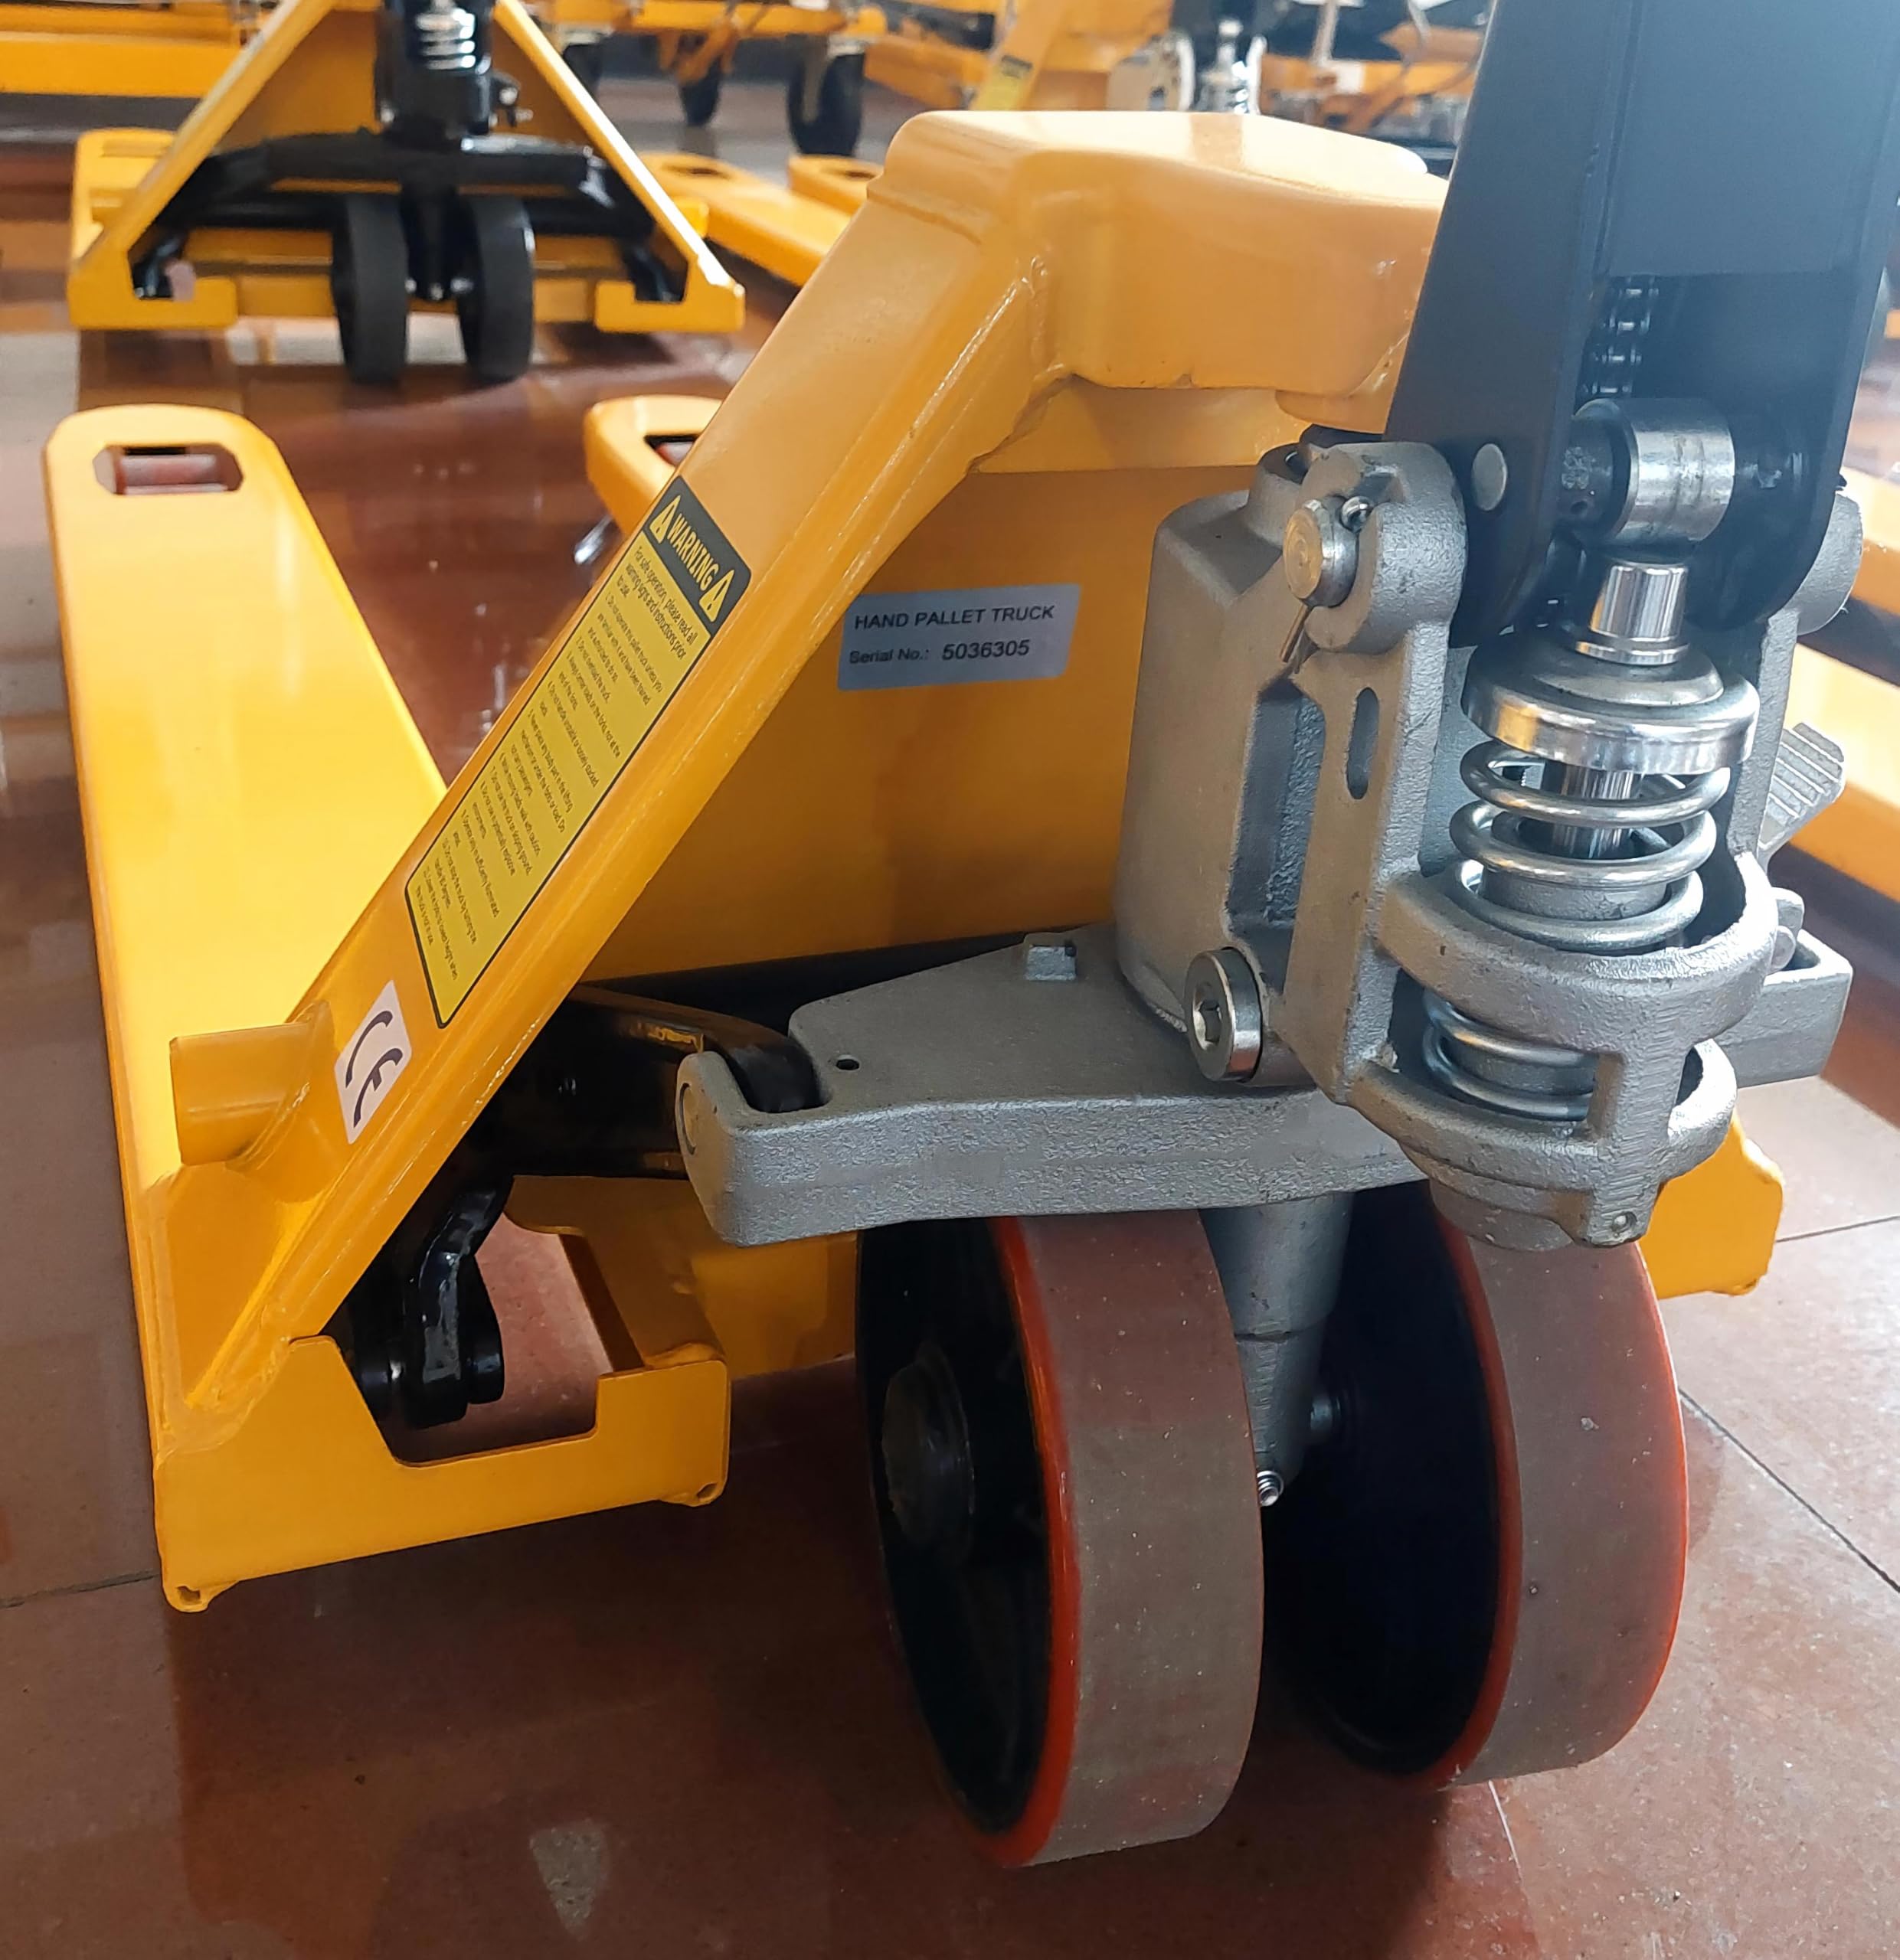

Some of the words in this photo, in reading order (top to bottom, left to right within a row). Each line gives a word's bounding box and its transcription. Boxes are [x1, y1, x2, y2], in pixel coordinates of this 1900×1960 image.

[667, 513, 718, 590] WARNING
[637, 582, 649, 602] signs
[645, 596, 659, 612] and
[652, 605, 677, 645] instructions
[670, 640, 686, 660] prior
[639, 557, 650, 573] safe
[663, 598, 680, 622] please
[677, 618, 692, 637] read
[686, 632, 698, 645] all
[854, 612, 909, 630] HAND
[914, 609, 985, 627] PALLET
[992, 605, 1055, 622] TRUCK
[849, 649, 894, 664] Serial
[897, 647, 930, 661] No.:
[942, 639, 1031, 661] 5036305
[345, 1010, 404, 1129] CE
